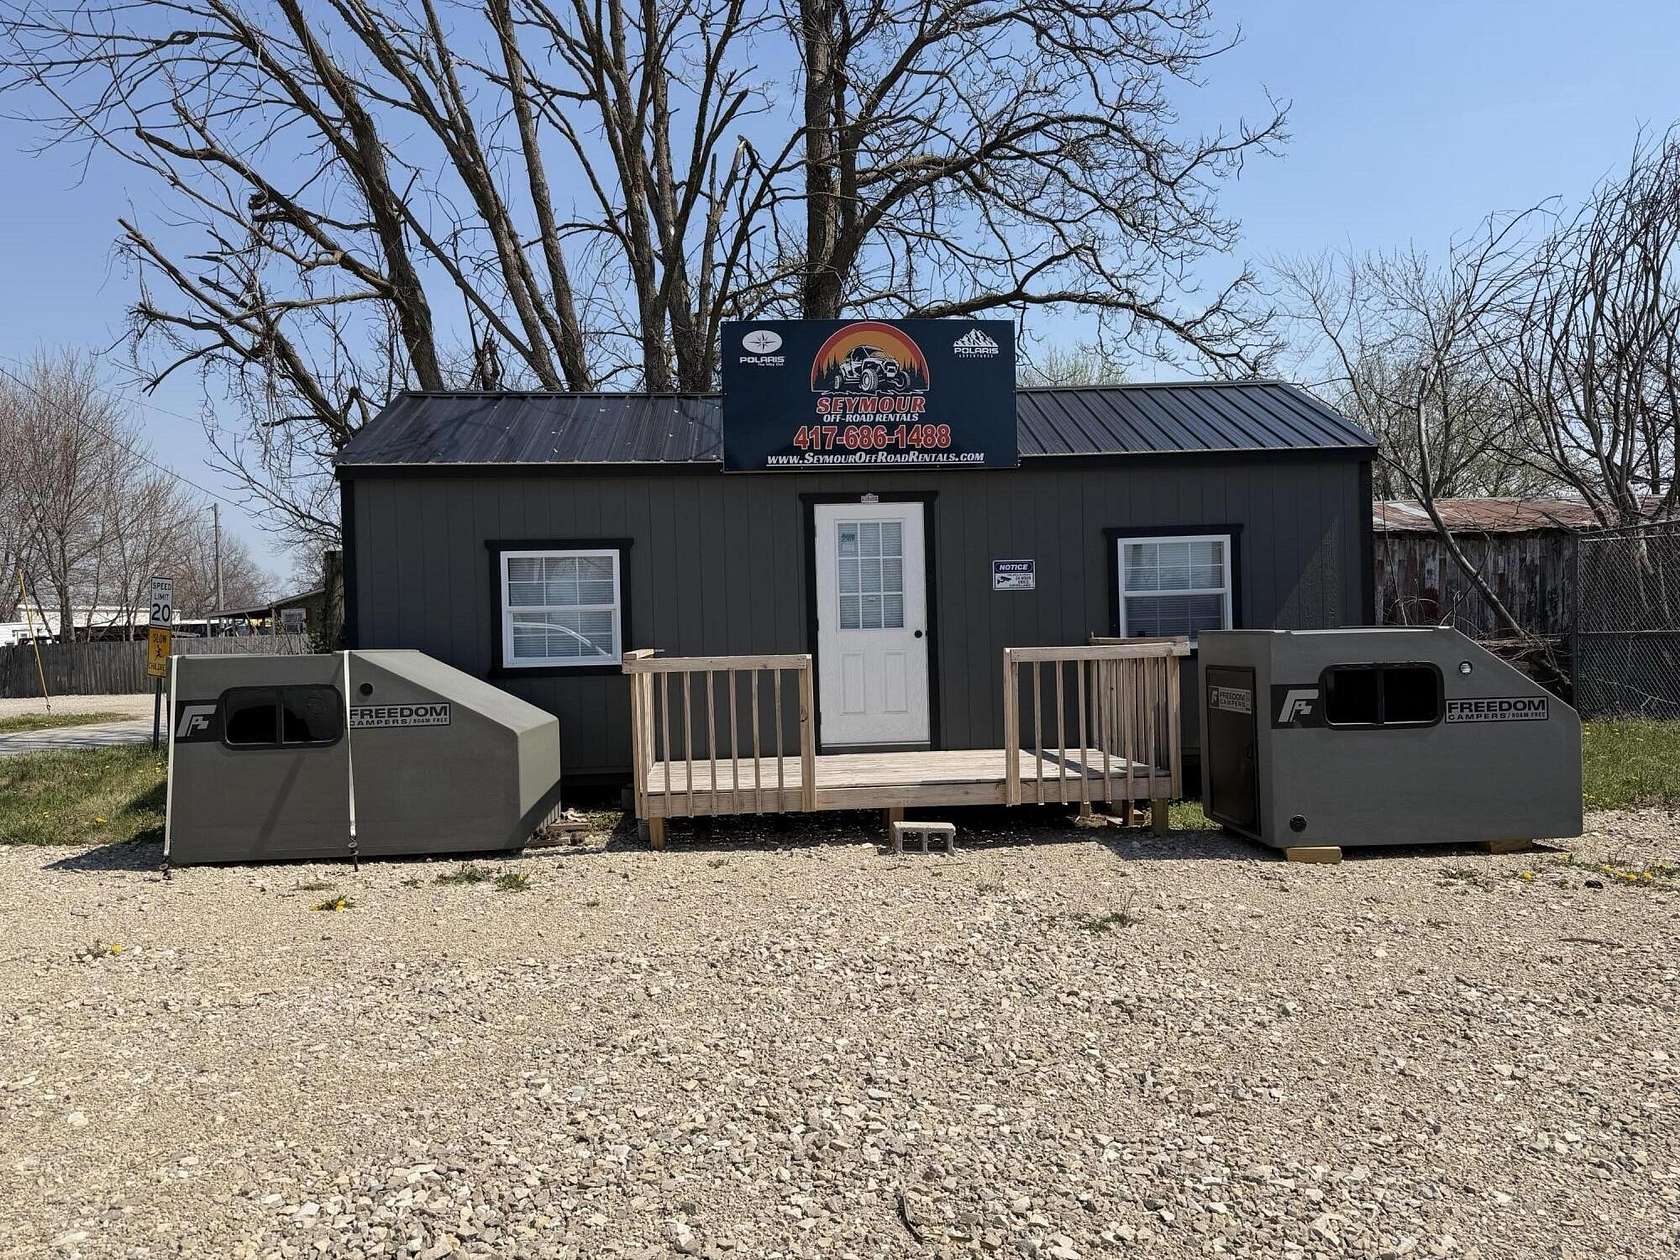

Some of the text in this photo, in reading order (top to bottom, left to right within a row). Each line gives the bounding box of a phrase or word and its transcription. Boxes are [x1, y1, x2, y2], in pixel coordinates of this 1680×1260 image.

[739, 356, 785, 364] POLARIS
[816, 396, 926, 414] SEYMOUR
[823, 413, 919, 423] OFF-ROAD RENTALS
[793, 424, 952, 450] 417-686-1488
[999, 563, 1029, 571] NOTICE
[152, 582, 172, 591] SPEED
[154, 593, 170, 601] LIMIT
[151, 603, 171, 622] 20
[1447, 700, 1546, 713] FREEDOM
[350, 706, 448, 720] FREEDOM
